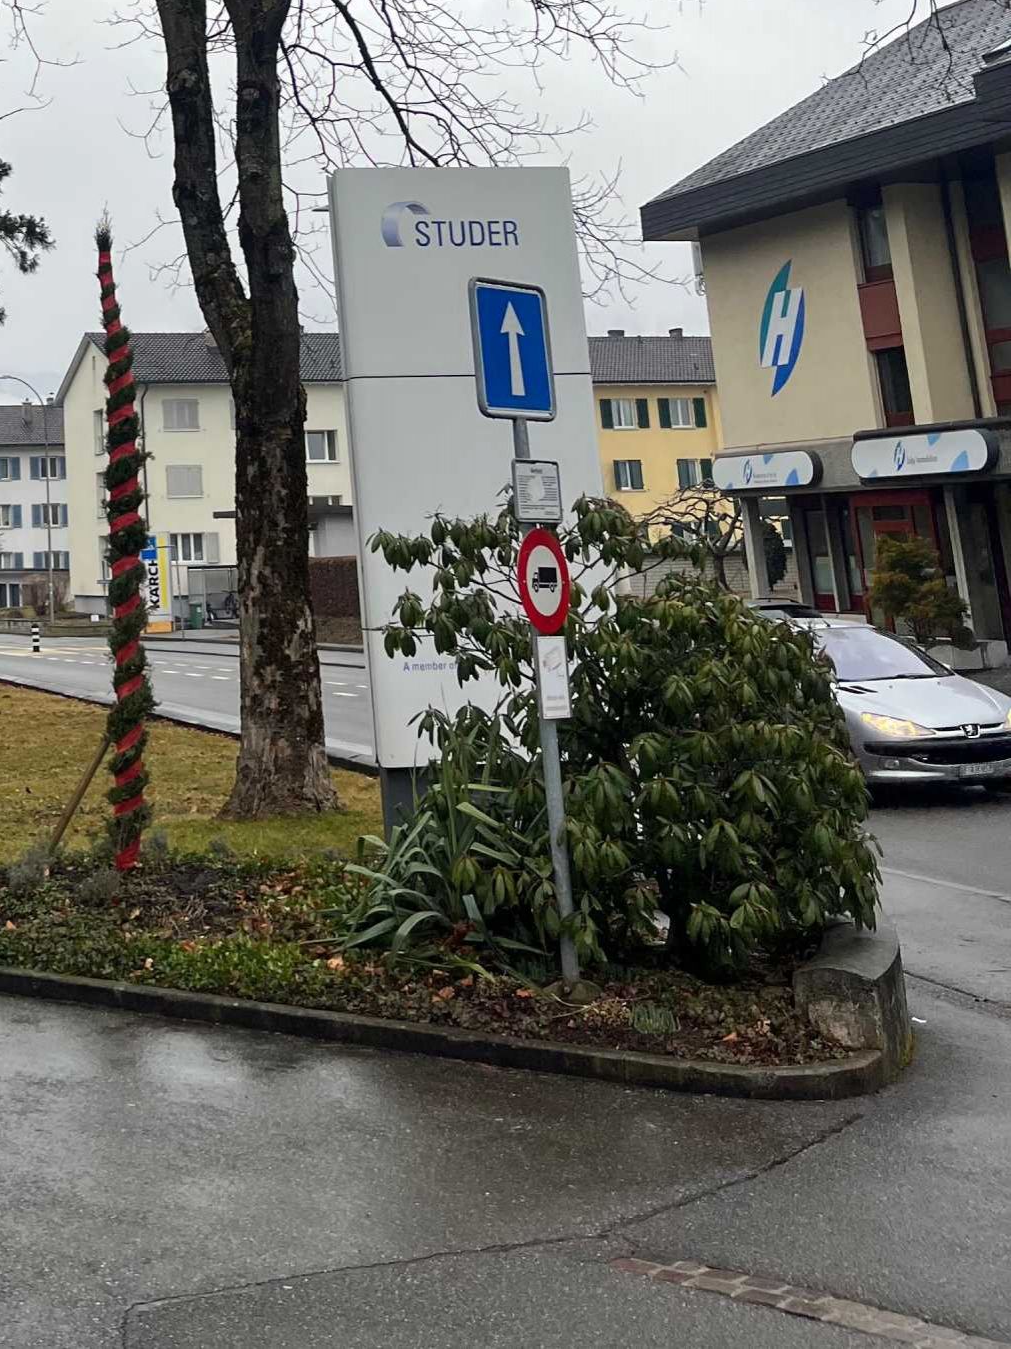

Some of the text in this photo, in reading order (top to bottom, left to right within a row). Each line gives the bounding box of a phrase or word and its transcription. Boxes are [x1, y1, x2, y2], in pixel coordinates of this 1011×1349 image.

[414, 220, 519, 247] STUDER
[403, 661, 410, 671] A
[412, 662, 447, 671] member
